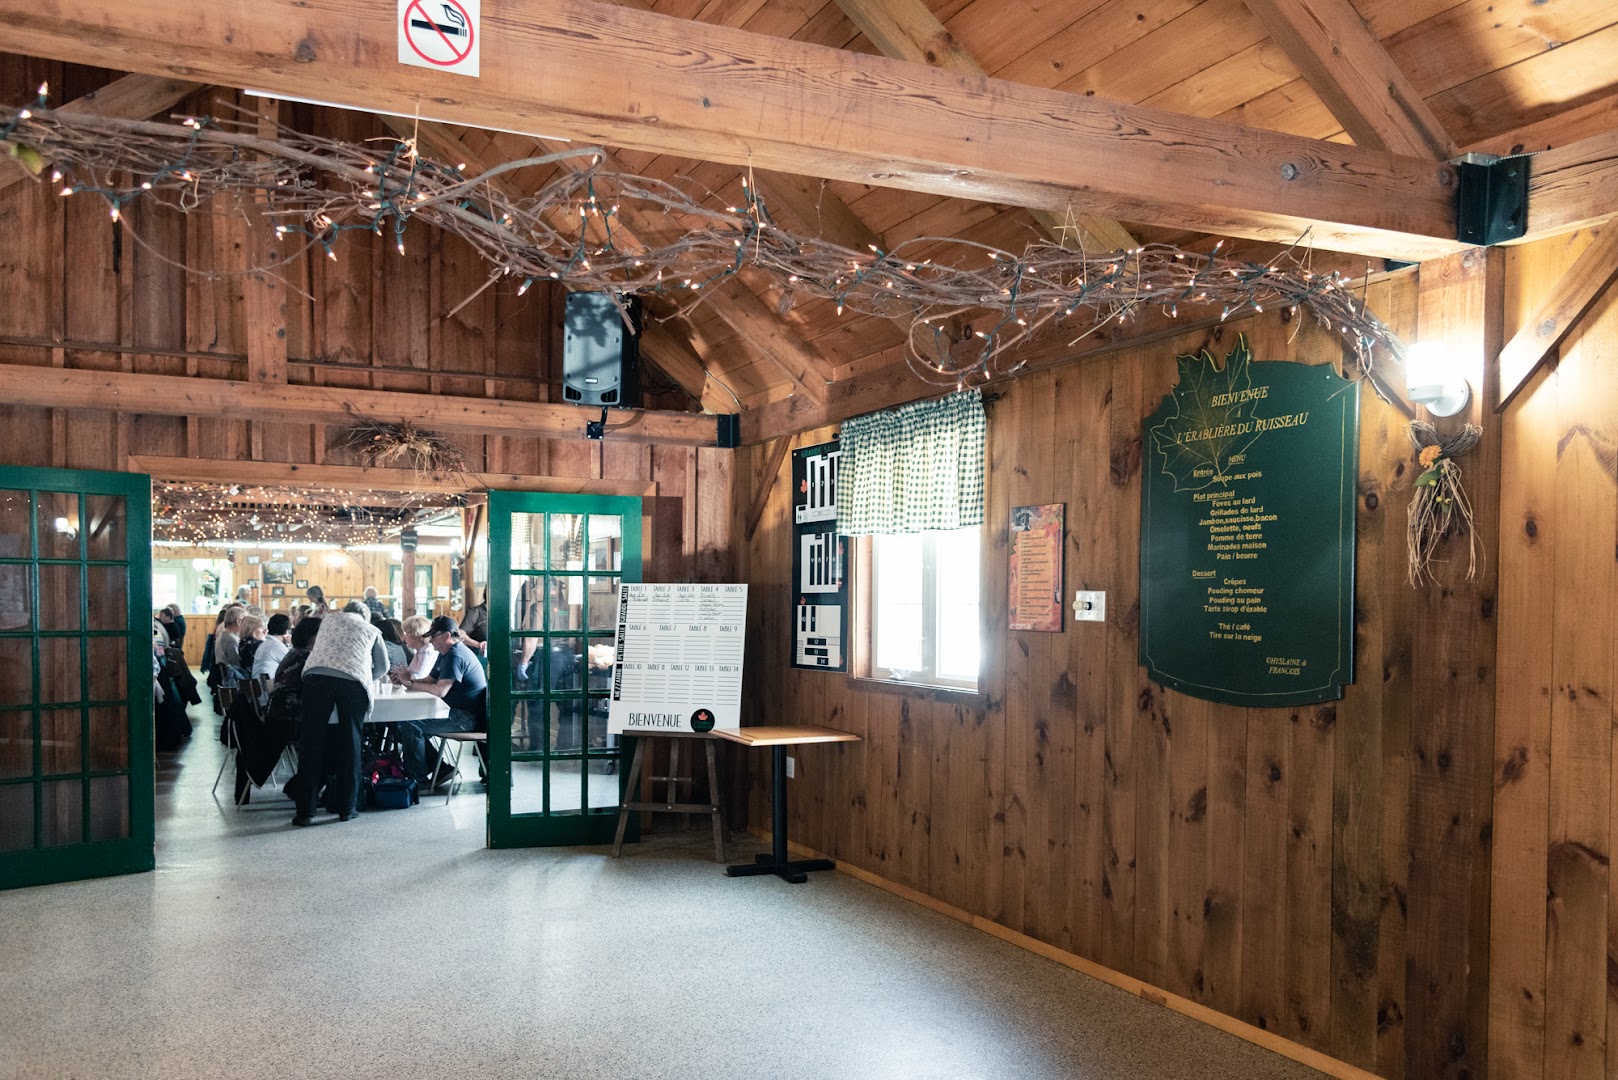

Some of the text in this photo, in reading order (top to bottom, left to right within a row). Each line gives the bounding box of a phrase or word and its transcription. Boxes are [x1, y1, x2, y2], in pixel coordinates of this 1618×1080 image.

[1211, 386, 1270, 407] BIENVENUE
[1177, 412, 1309, 443] L'ÉRABLIÈRE DU RUISSEAU
[1212, 470, 1262, 482] Soupe aux pois
[1206, 490, 1235, 500] principal
[1242, 496, 1256, 504] lard
[1210, 508, 1238, 516] Grillades
[1240, 506, 1248, 514] de
[1246, 597, 1261, 605] pain
[1235, 632, 1242, 640] la
[1243, 634, 1262, 642] neige
[1266, 657, 1300, 666] GHYSLAINE
[629, 712, 682, 727] BIENVENUE
